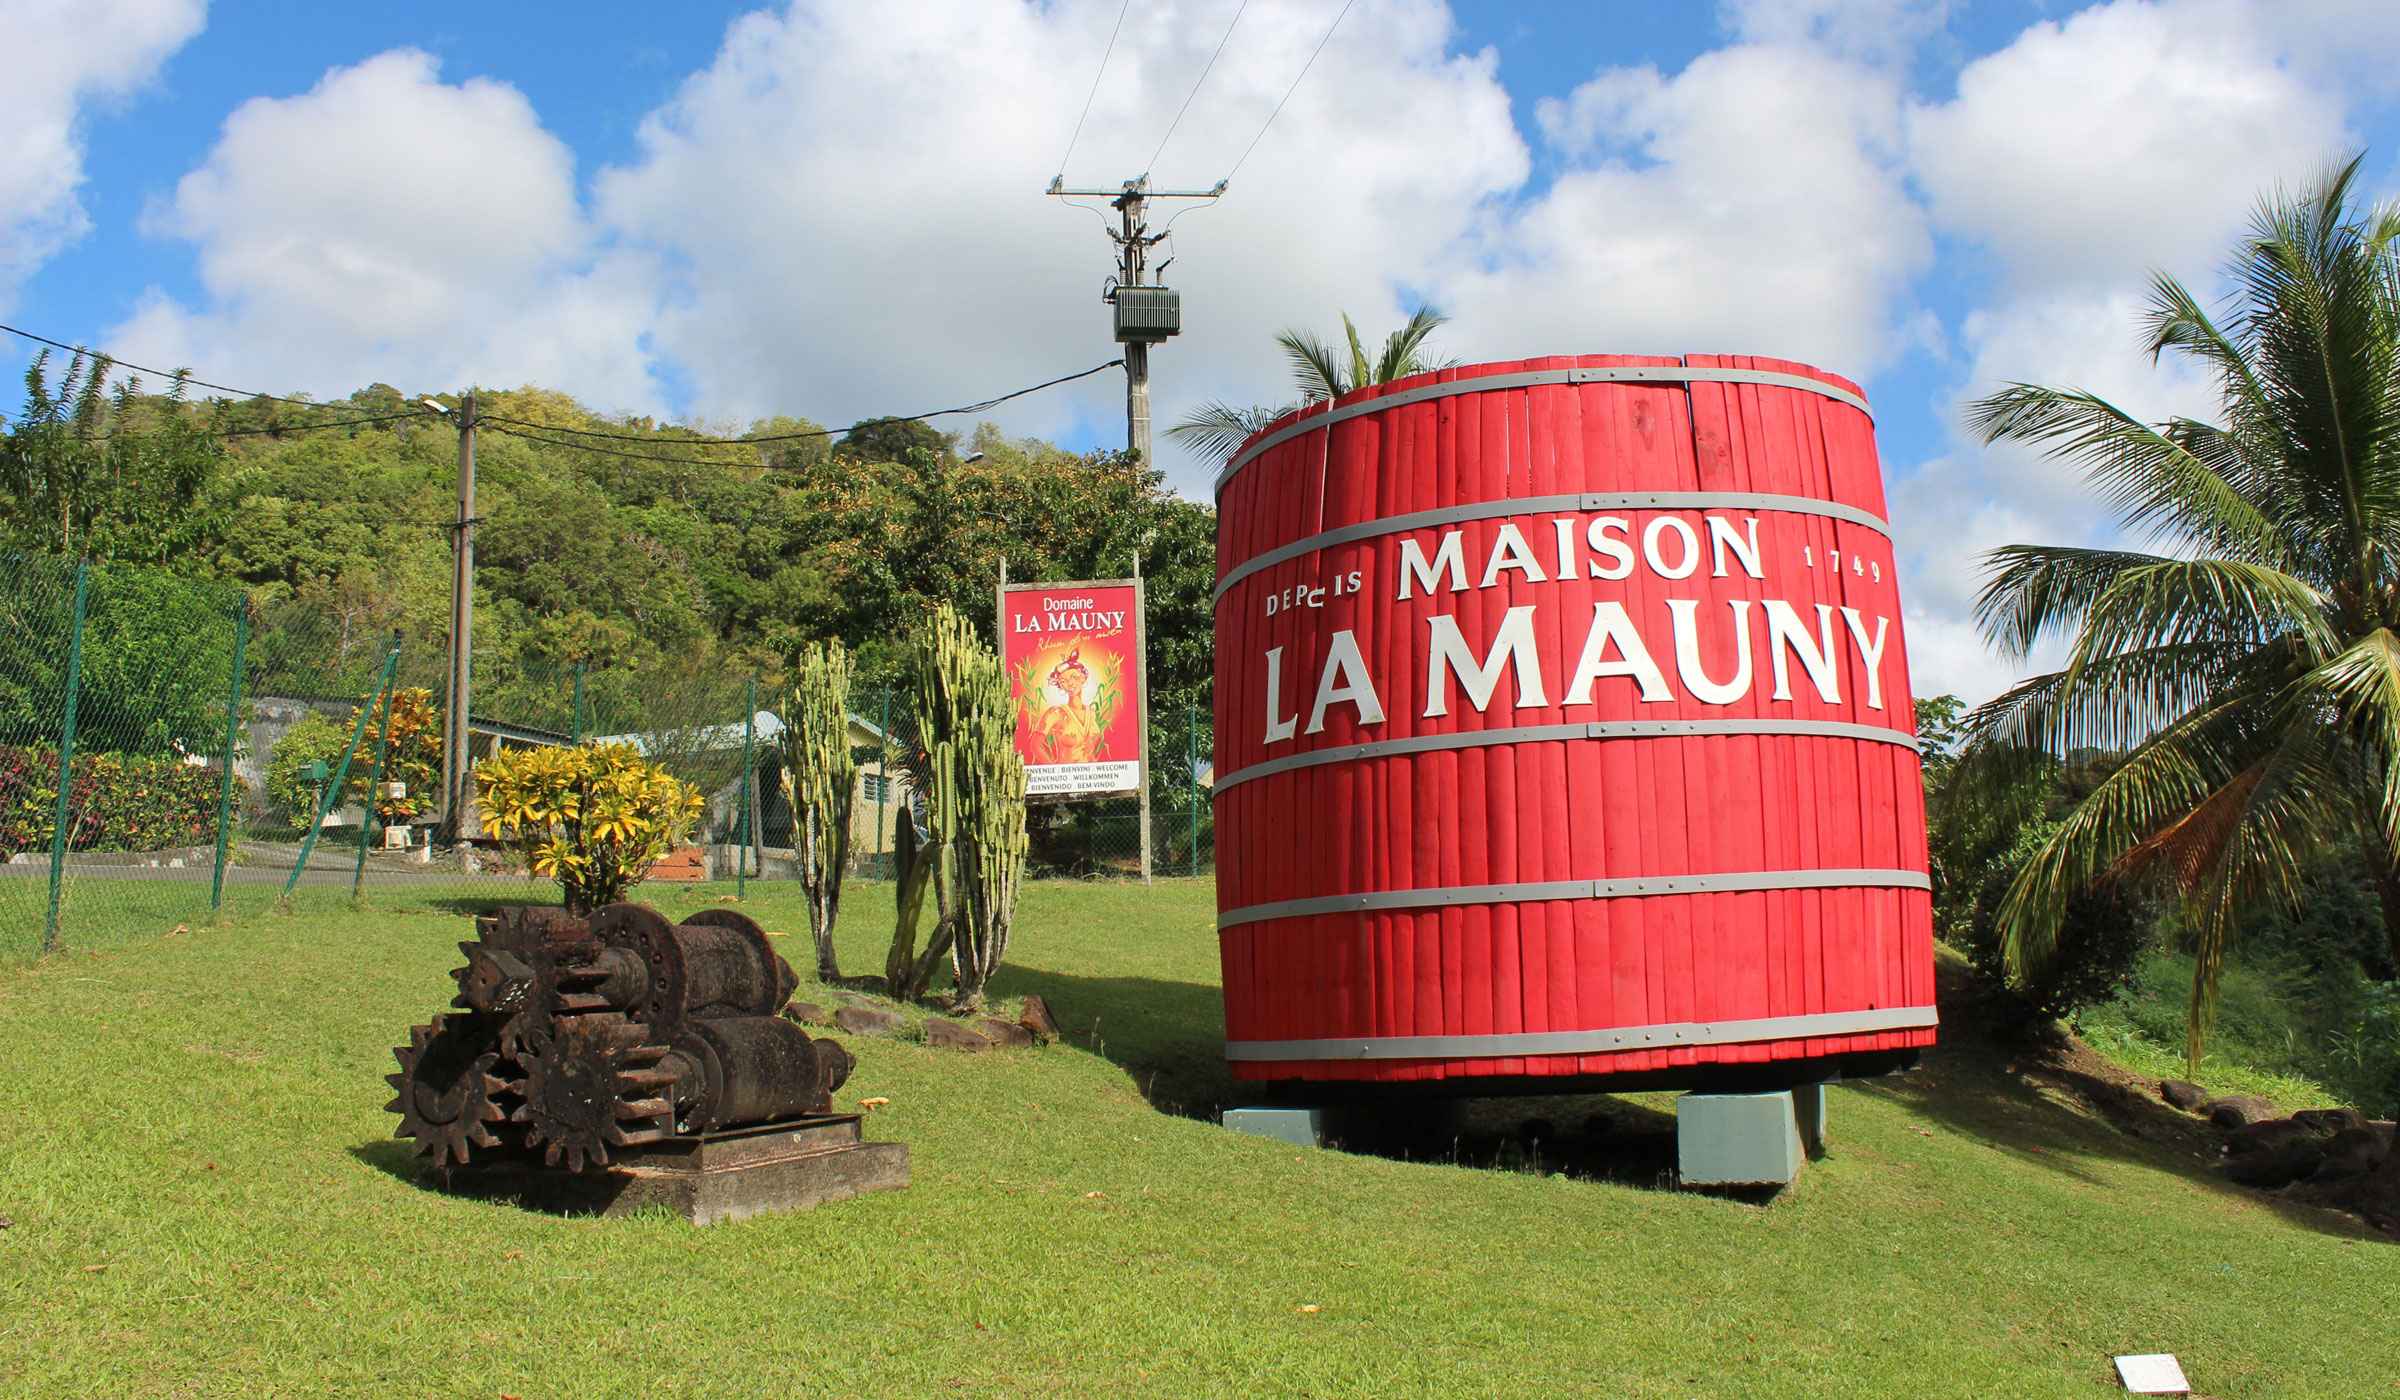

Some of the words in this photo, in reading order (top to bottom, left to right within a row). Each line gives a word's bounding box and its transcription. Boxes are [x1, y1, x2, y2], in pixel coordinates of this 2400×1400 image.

[1397, 515, 1766, 601] MAISON
[1803, 545, 1881, 583] 1749
[1043, 596, 1094, 611] Domaine
[1014, 613, 1042, 633] LA
[1047, 611, 1125, 632] MAUNY
[1263, 629, 1387, 744] LA
[1422, 599, 1889, 718] MAUNY
[1073, 773, 1119, 781] WILLKOMMEN
[1031, 783, 1072, 791] BIENVENIDO
